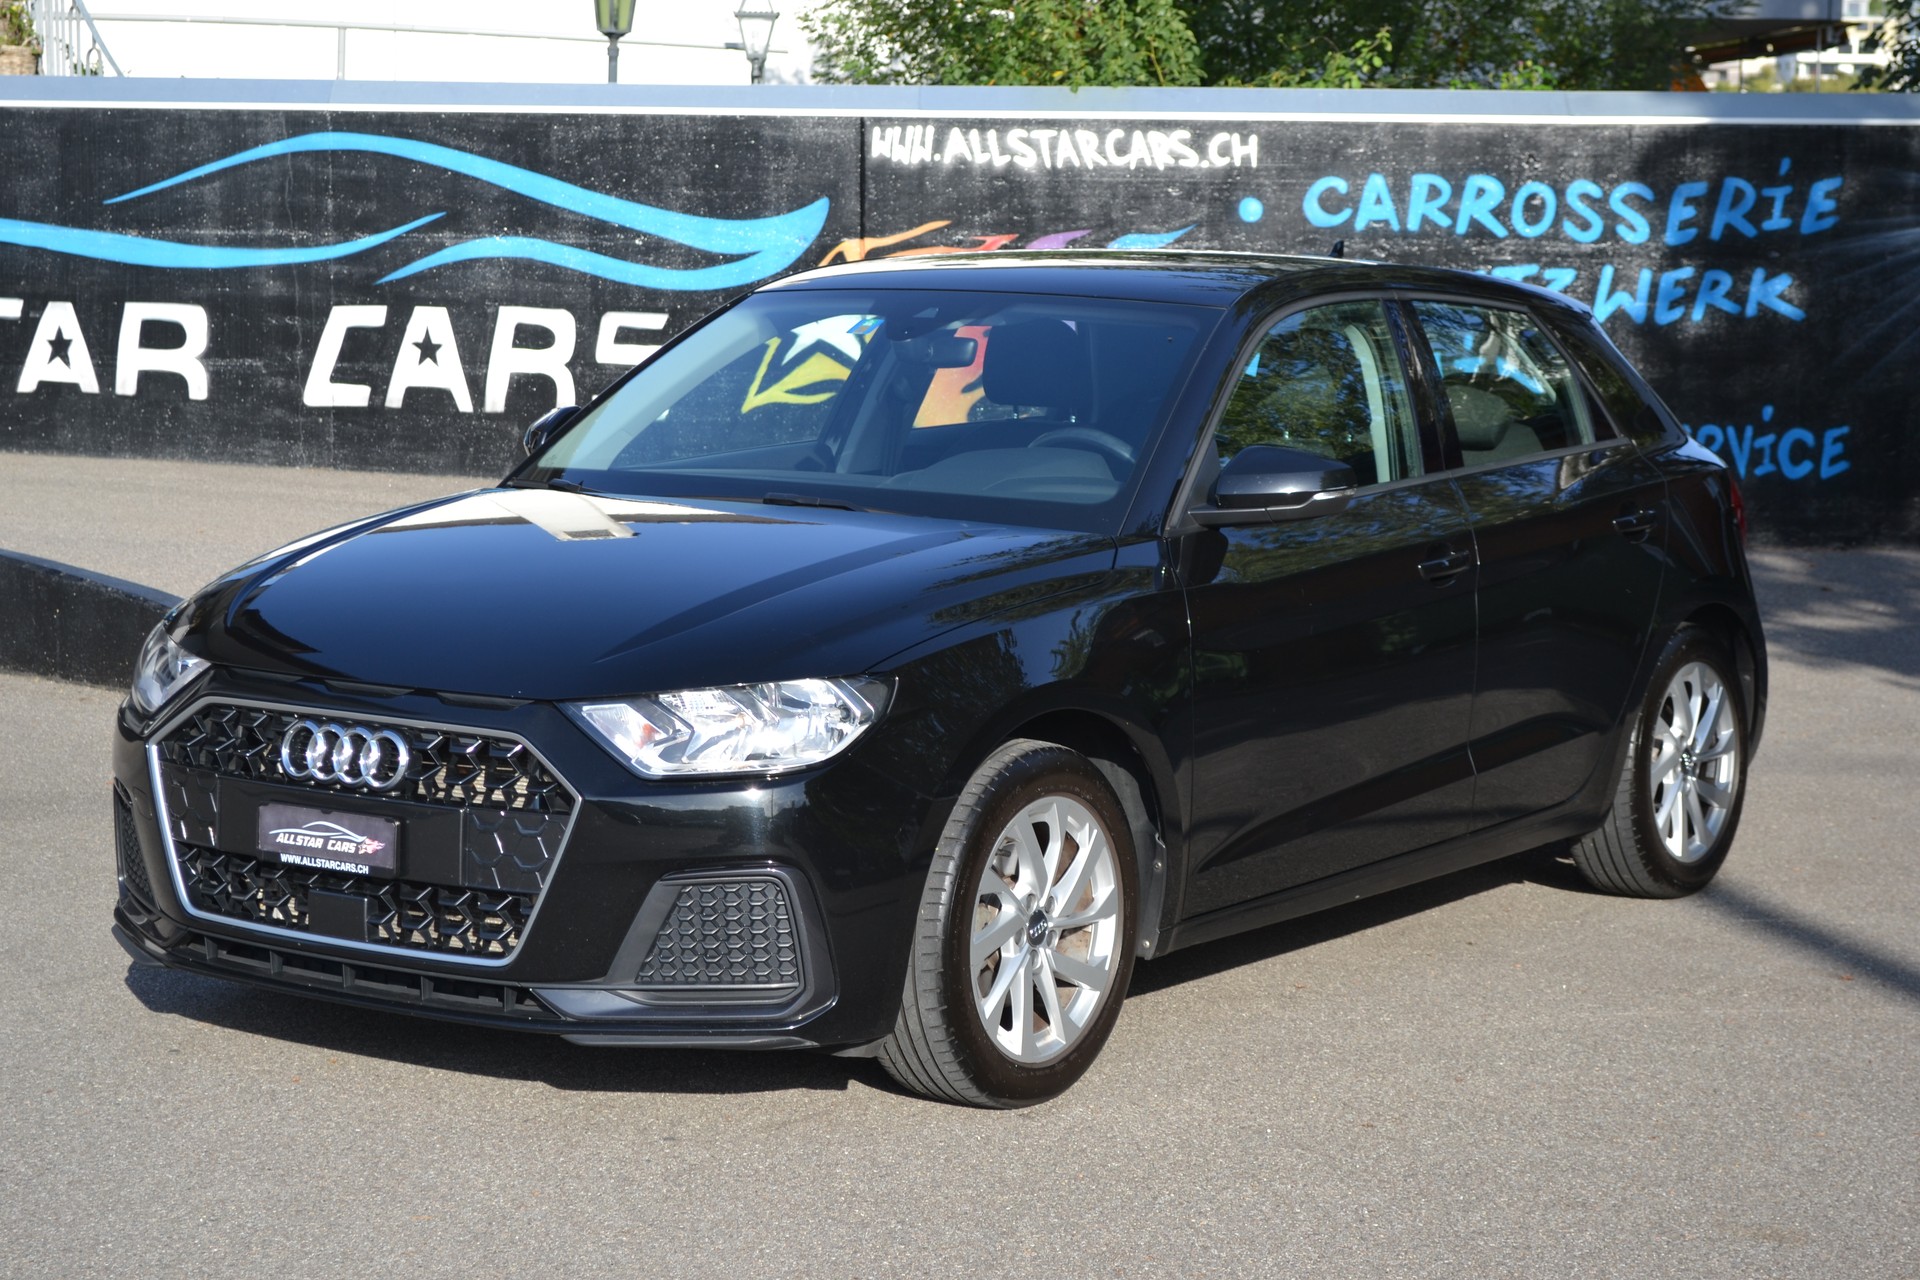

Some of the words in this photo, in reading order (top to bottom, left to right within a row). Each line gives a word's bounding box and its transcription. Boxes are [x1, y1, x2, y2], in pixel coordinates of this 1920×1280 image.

[871, 125, 1260, 171] WWW.ALLSTARCARS.CH
[276, 833, 324, 849] ALLSTAR
[327, 839, 357, 854] CARS
[280, 854, 369, 875] WWW.ALLSTARCARS.CH
